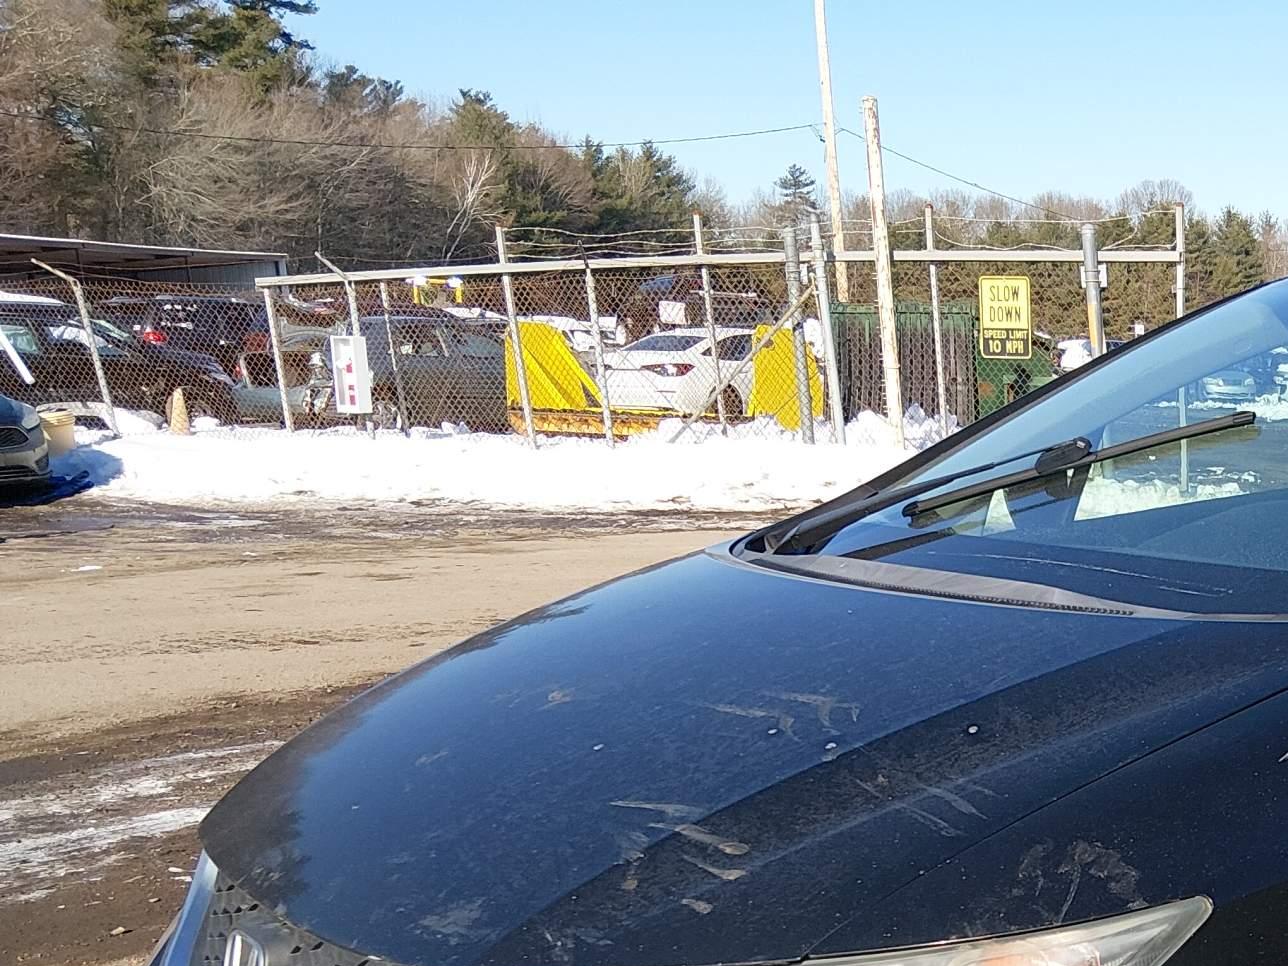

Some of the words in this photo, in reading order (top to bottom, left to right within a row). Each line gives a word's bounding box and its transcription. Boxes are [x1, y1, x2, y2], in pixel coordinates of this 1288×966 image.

[989, 285, 1020, 302] SLOW
[989, 306, 1021, 323] DOWN
[984, 329, 1007, 339] SPEED
[1008, 330, 1028, 339] LIMIT
[989, 340, 1002, 353] 10
[1006, 340, 1024, 354] MPH
